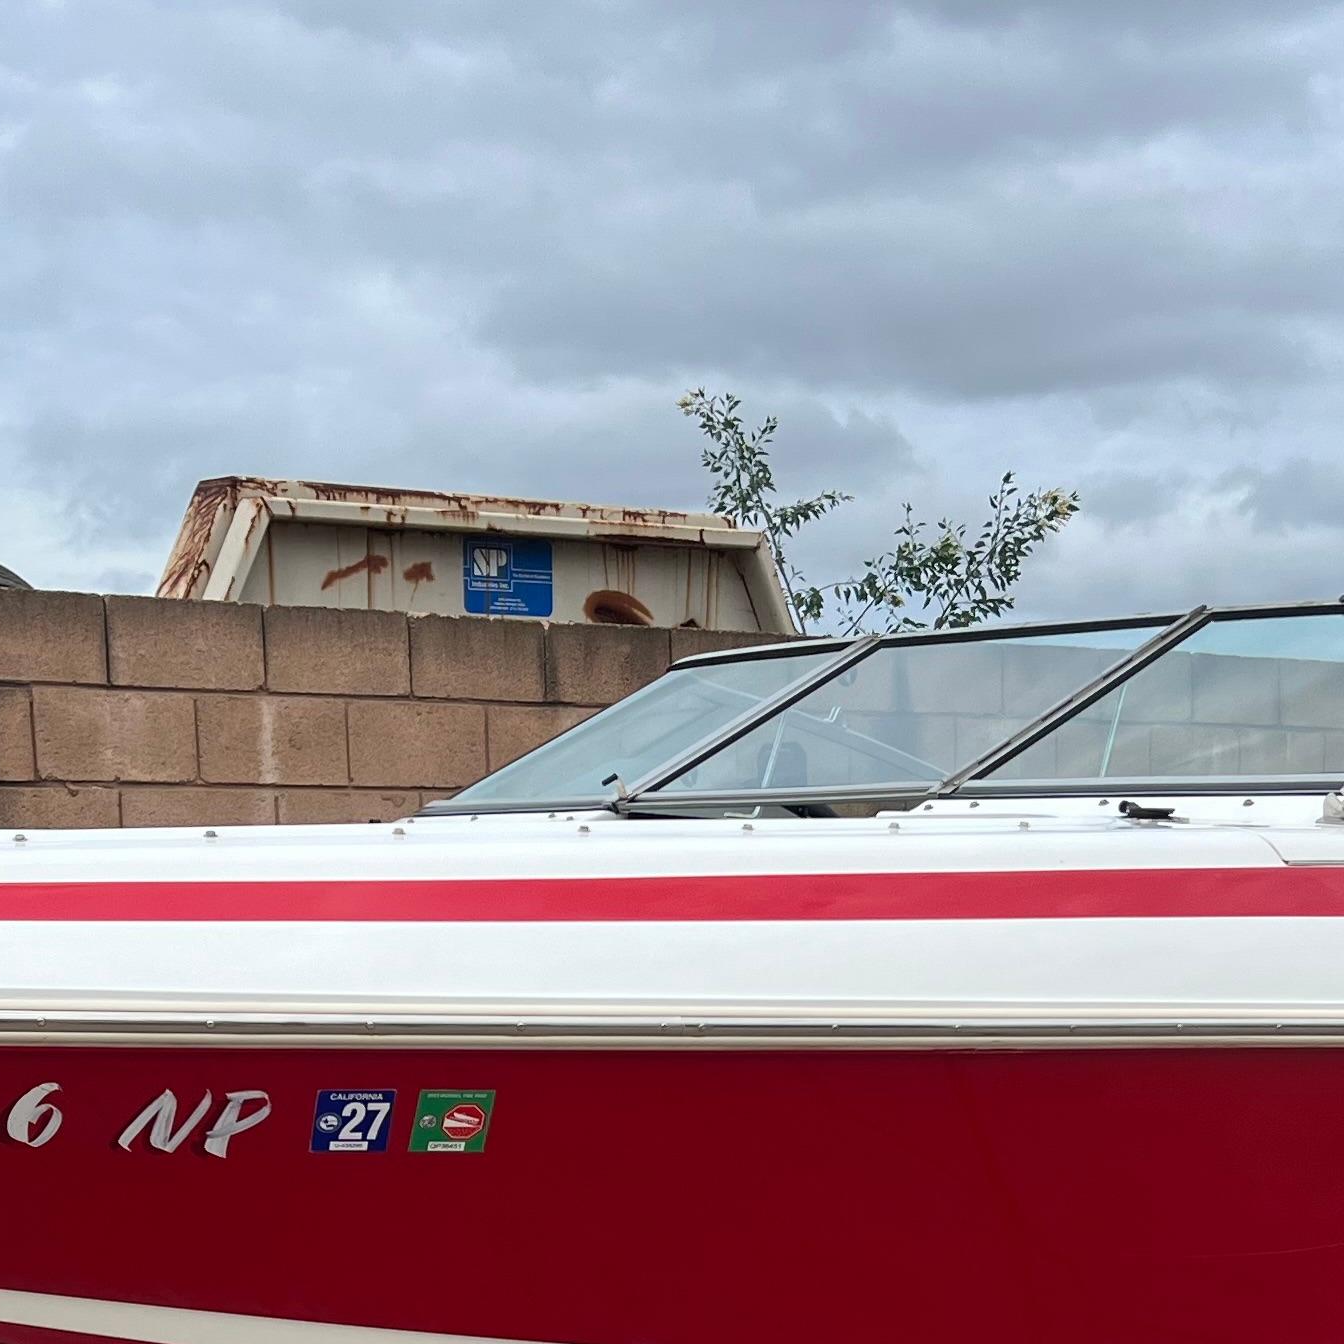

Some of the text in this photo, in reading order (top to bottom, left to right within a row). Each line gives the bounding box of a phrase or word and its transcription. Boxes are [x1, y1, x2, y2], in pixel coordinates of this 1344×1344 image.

[329, 1092, 383, 1101] CALIFORNIA
[117, 1088, 272, 1159] NP
[338, 1101, 391, 1141] 27
